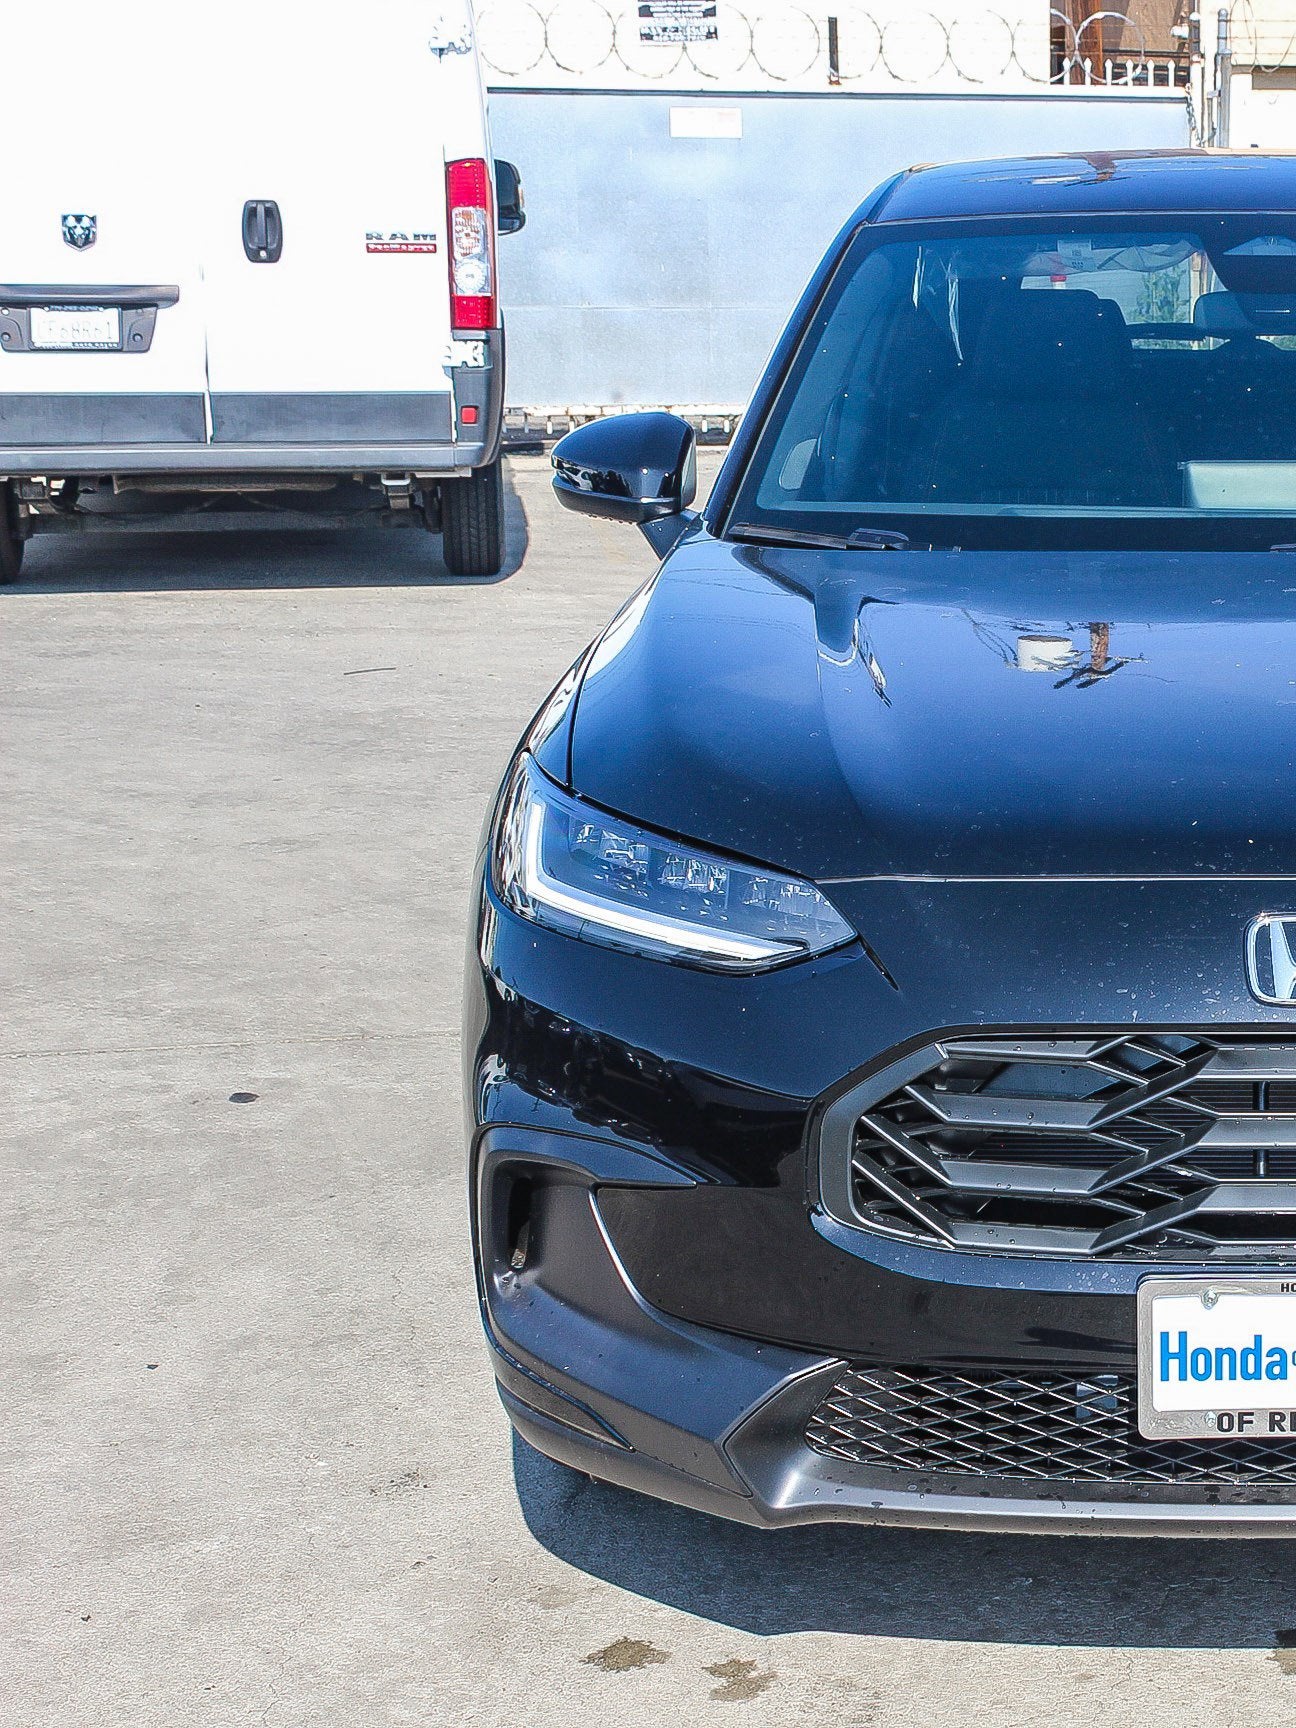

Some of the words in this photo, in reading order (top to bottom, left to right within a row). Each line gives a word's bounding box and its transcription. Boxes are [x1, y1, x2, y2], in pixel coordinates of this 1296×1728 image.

[365, 232, 437, 241] RAM
[1160, 1331, 1288, 1382] Honda
[1217, 1411, 1255, 1433] OF
